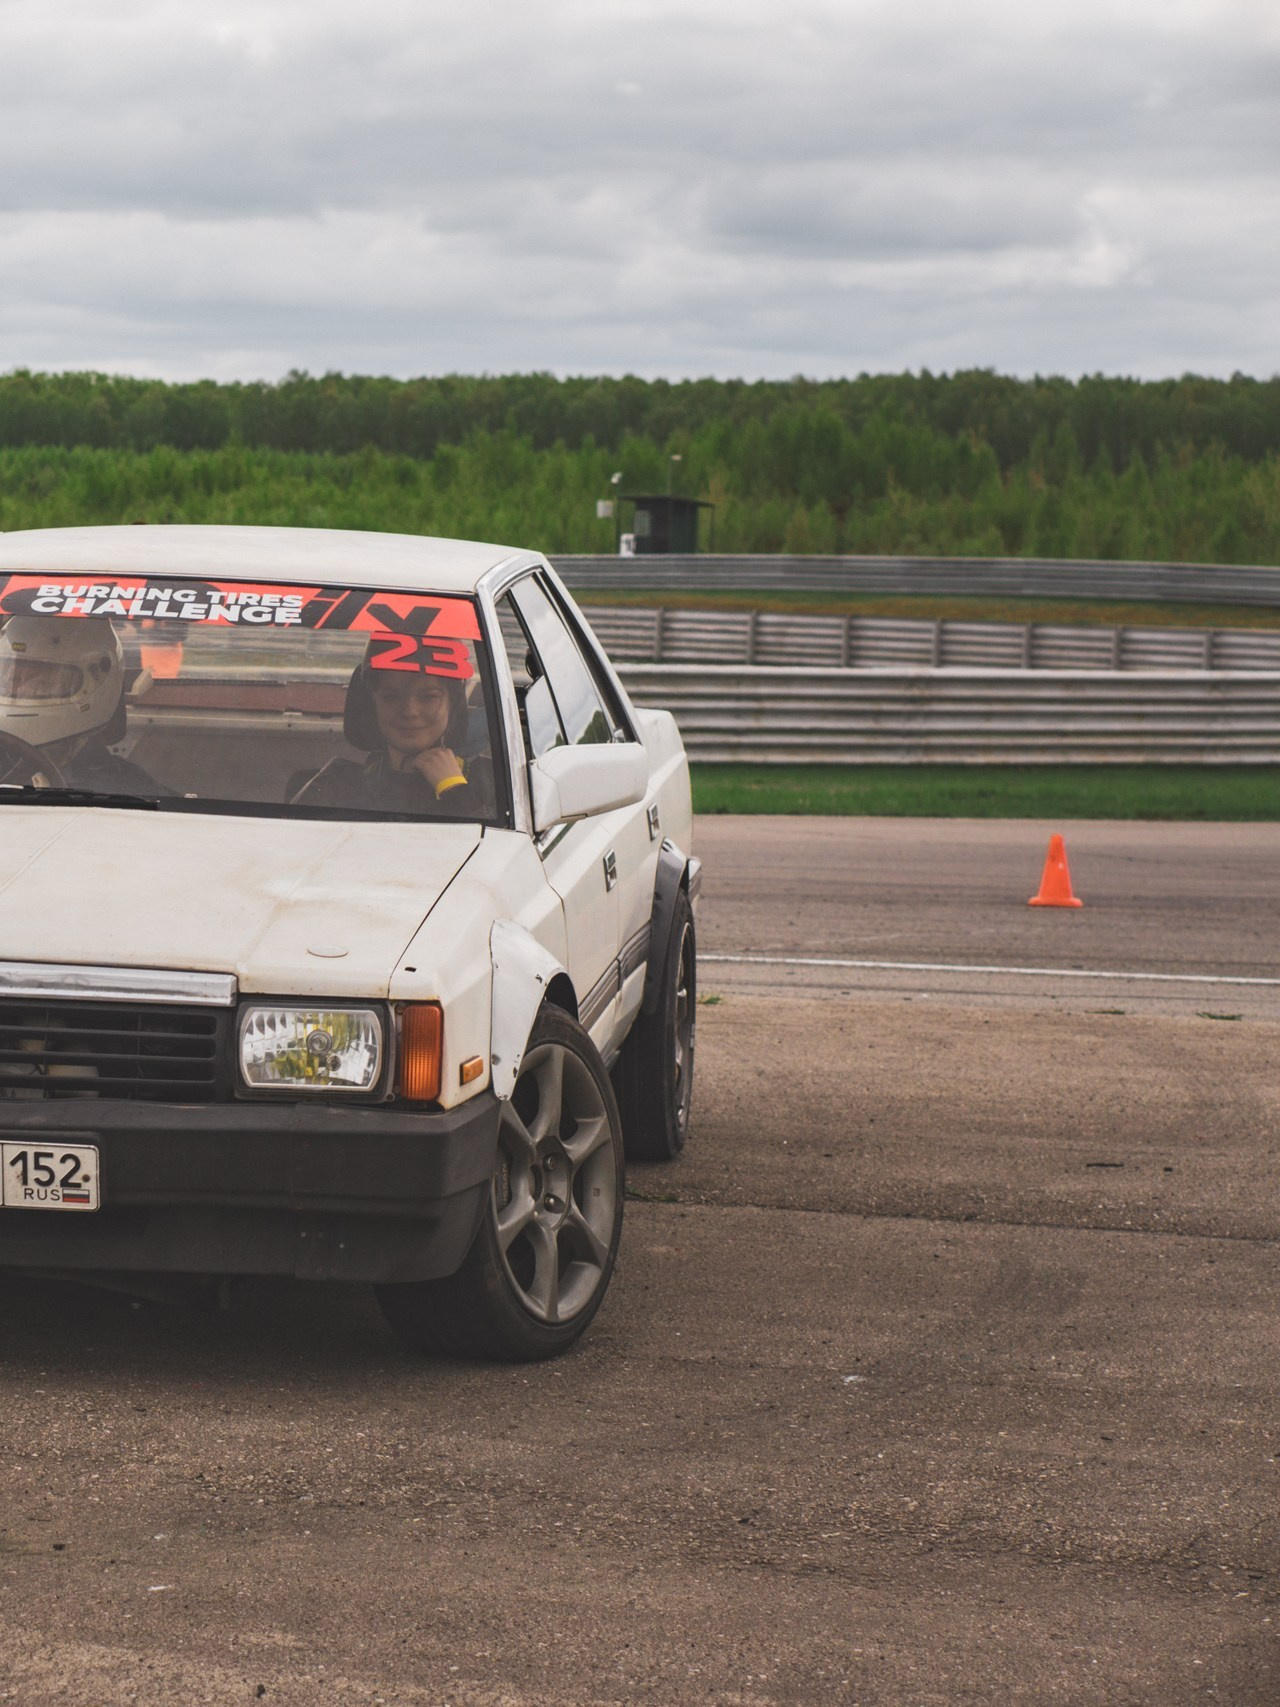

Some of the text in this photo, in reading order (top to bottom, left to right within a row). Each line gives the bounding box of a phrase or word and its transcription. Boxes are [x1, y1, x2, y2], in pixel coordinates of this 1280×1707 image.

[30, 596, 302, 624] CHALLENGE
[36, 584, 304, 608] BURNING TIRES
[370, 630, 474, 680] 23
[9, 1149, 83, 1189] 152
[23, 1187, 61, 1202] RUS
